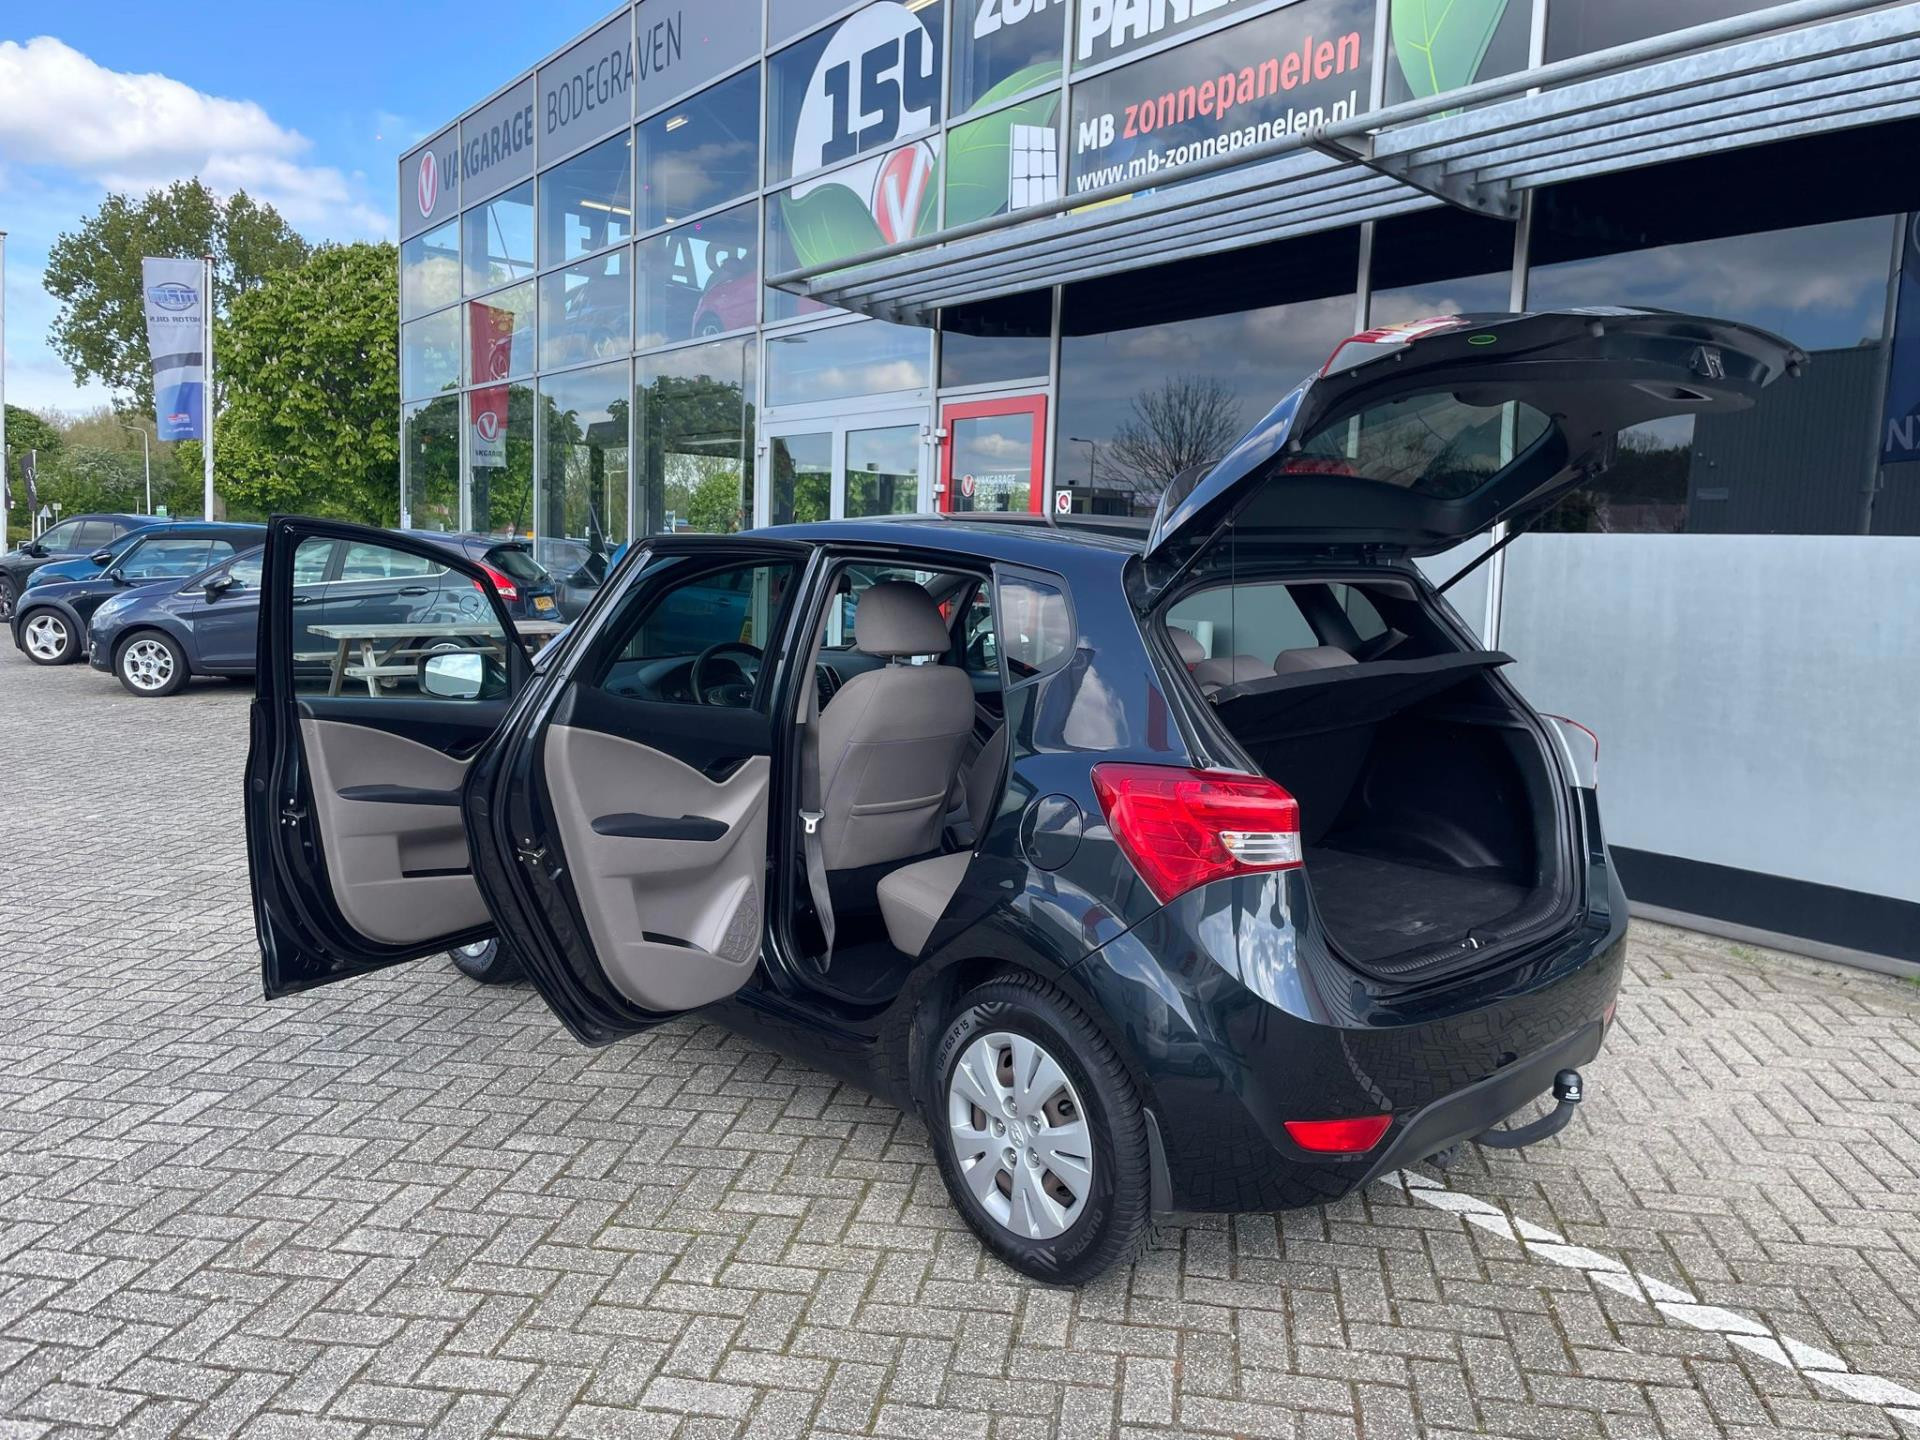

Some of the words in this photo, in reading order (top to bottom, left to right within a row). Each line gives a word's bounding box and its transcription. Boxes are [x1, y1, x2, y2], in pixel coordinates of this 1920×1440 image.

[443, 105, 533, 190] VAKGARAGE
[547, 11, 682, 135] BODEGRAVEN
[822, 27, 933, 166] 154
[1077, 90, 1357, 192] www.mb-zonnepanelen.nl
[1078, 113, 1115, 154] MB
[1123, 32, 1361, 139] zonnepanelen
